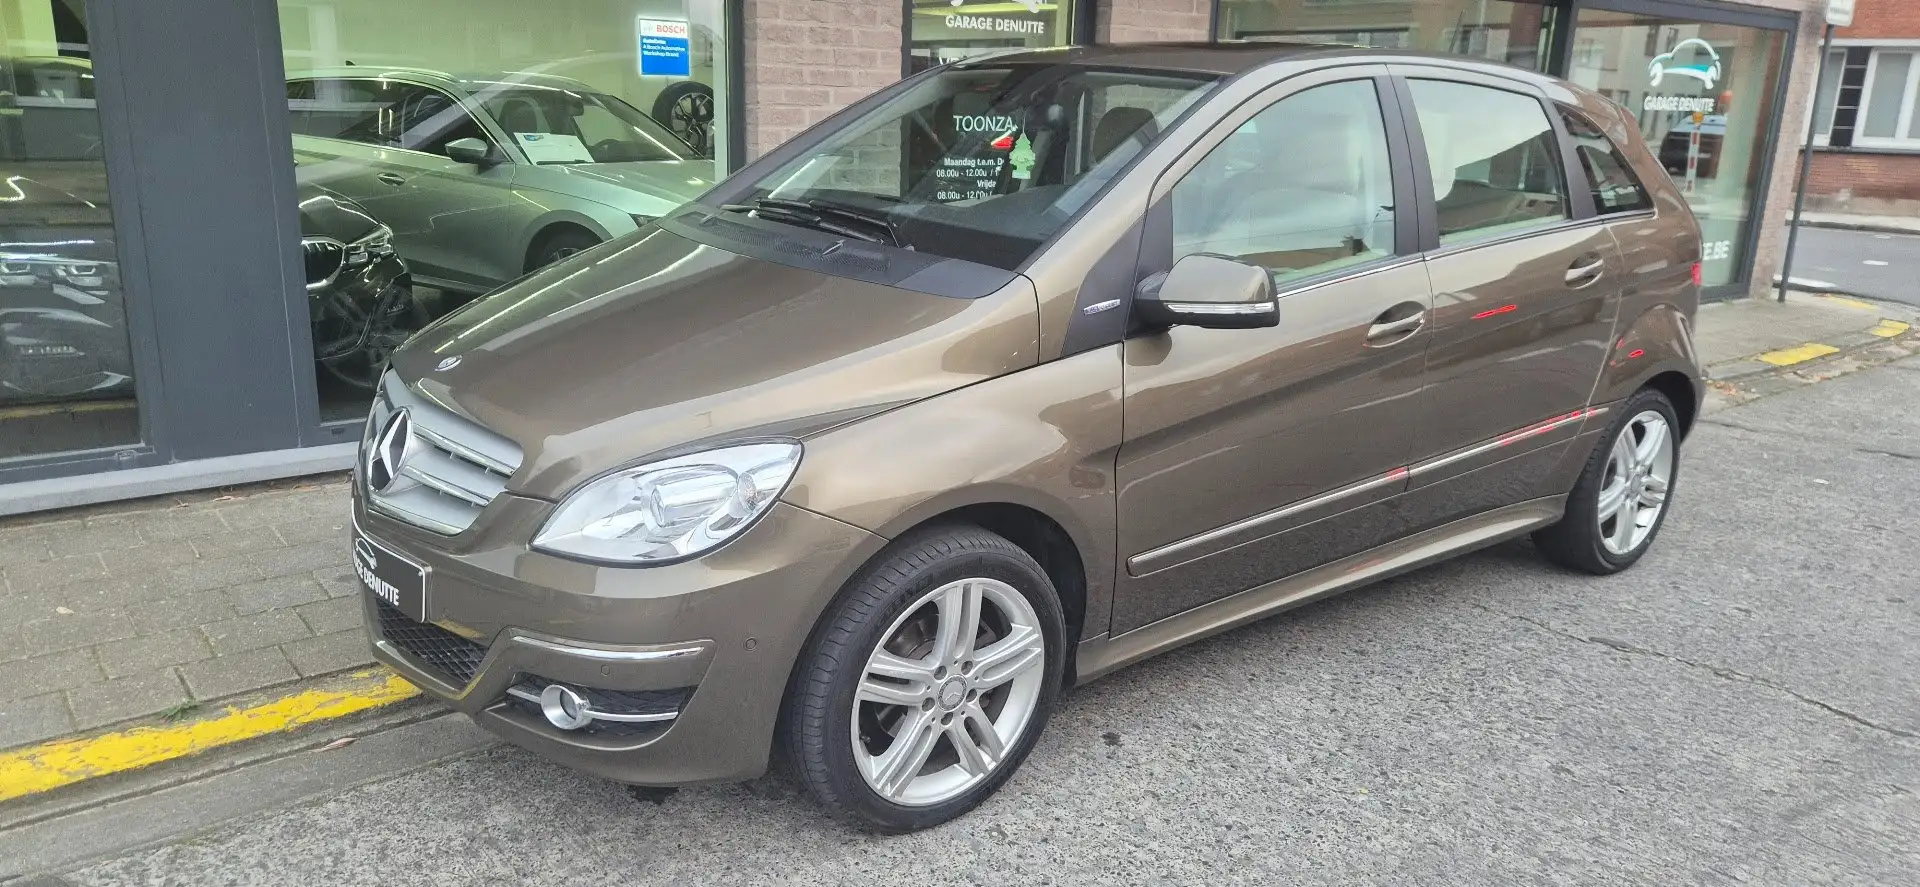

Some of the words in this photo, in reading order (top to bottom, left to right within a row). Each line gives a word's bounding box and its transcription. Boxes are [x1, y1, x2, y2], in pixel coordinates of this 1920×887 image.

[656, 24, 685, 34] BOSCH
[945, 15, 993, 31] GARAGE
[995, 18, 1045, 34] DENUTTE
[1643, 95, 1678, 111] GARAGE
[1679, 97, 1715, 113] DENUTTE
[944, 157, 976, 168] Maandag
[976, 157, 996, 166] t.e.m.
[966, 168, 987, 177] 12.00u
[363, 566, 400, 606] DENUTTE
